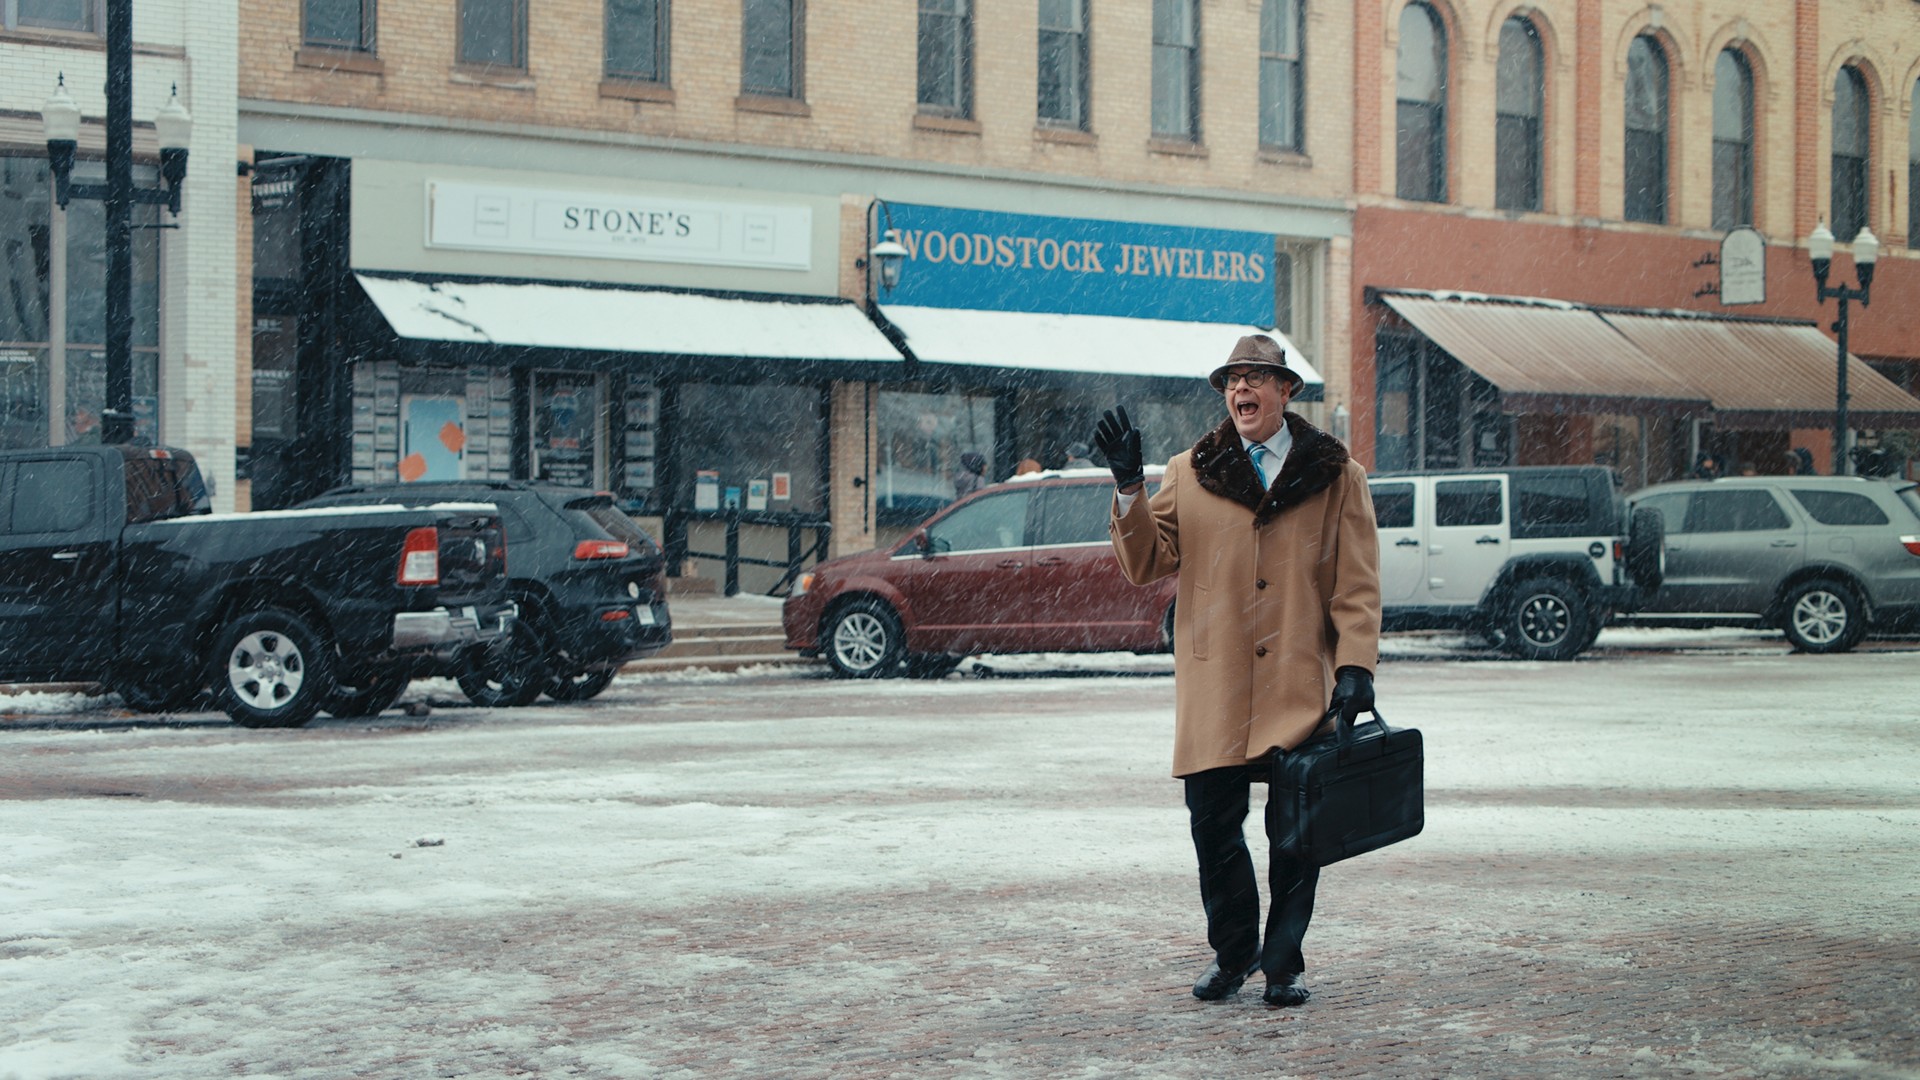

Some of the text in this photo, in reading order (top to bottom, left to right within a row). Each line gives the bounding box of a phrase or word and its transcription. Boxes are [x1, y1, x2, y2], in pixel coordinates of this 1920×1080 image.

[252, 181, 294, 197] TURNKEY
[564, 207, 690, 237] STONE'S
[894, 229, 1265, 283] WOODSTOCK JEWELERS
